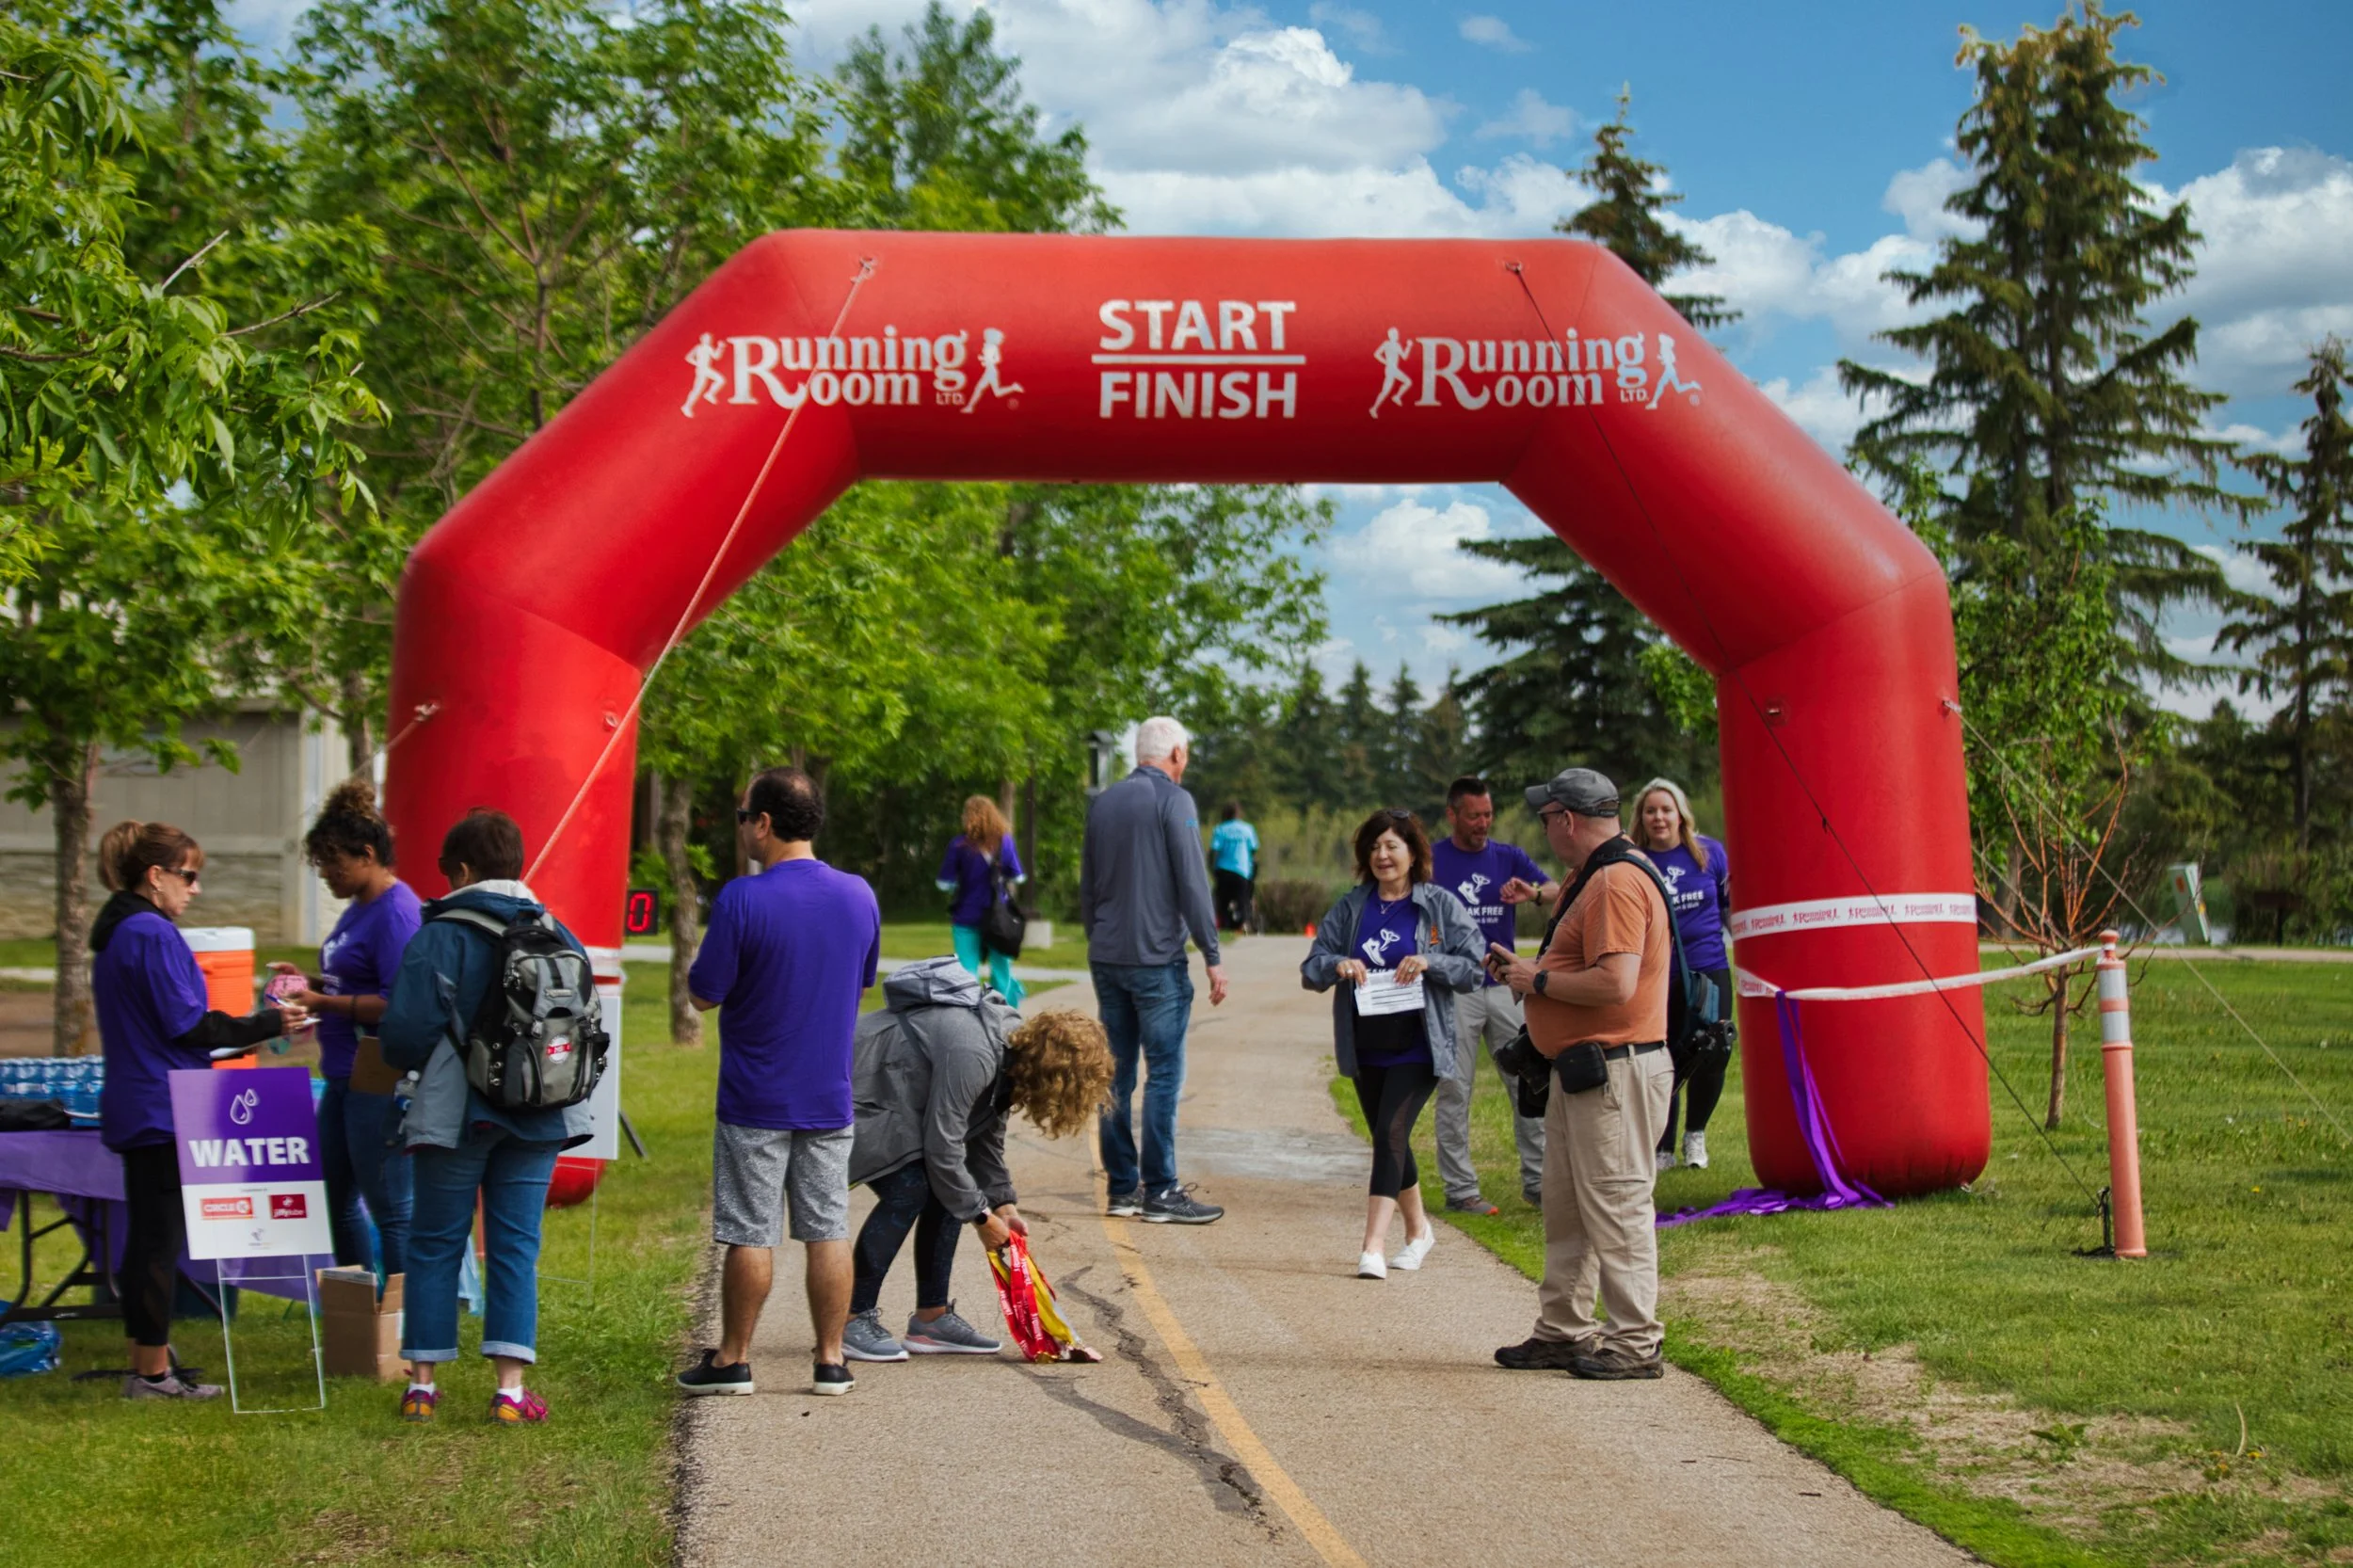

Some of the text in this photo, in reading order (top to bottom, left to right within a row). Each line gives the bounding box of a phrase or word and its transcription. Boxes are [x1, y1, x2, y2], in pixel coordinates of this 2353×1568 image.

[1098, 299, 1297, 351] START
[727, 325, 968, 408] Running
[1415, 328, 1646, 408] Running
[1098, 371, 1297, 419] FINISH
[628, 892, 651, 933] 0
[1481, 906, 1504, 916] FREE
[188, 1137, 312, 1167] WATER
